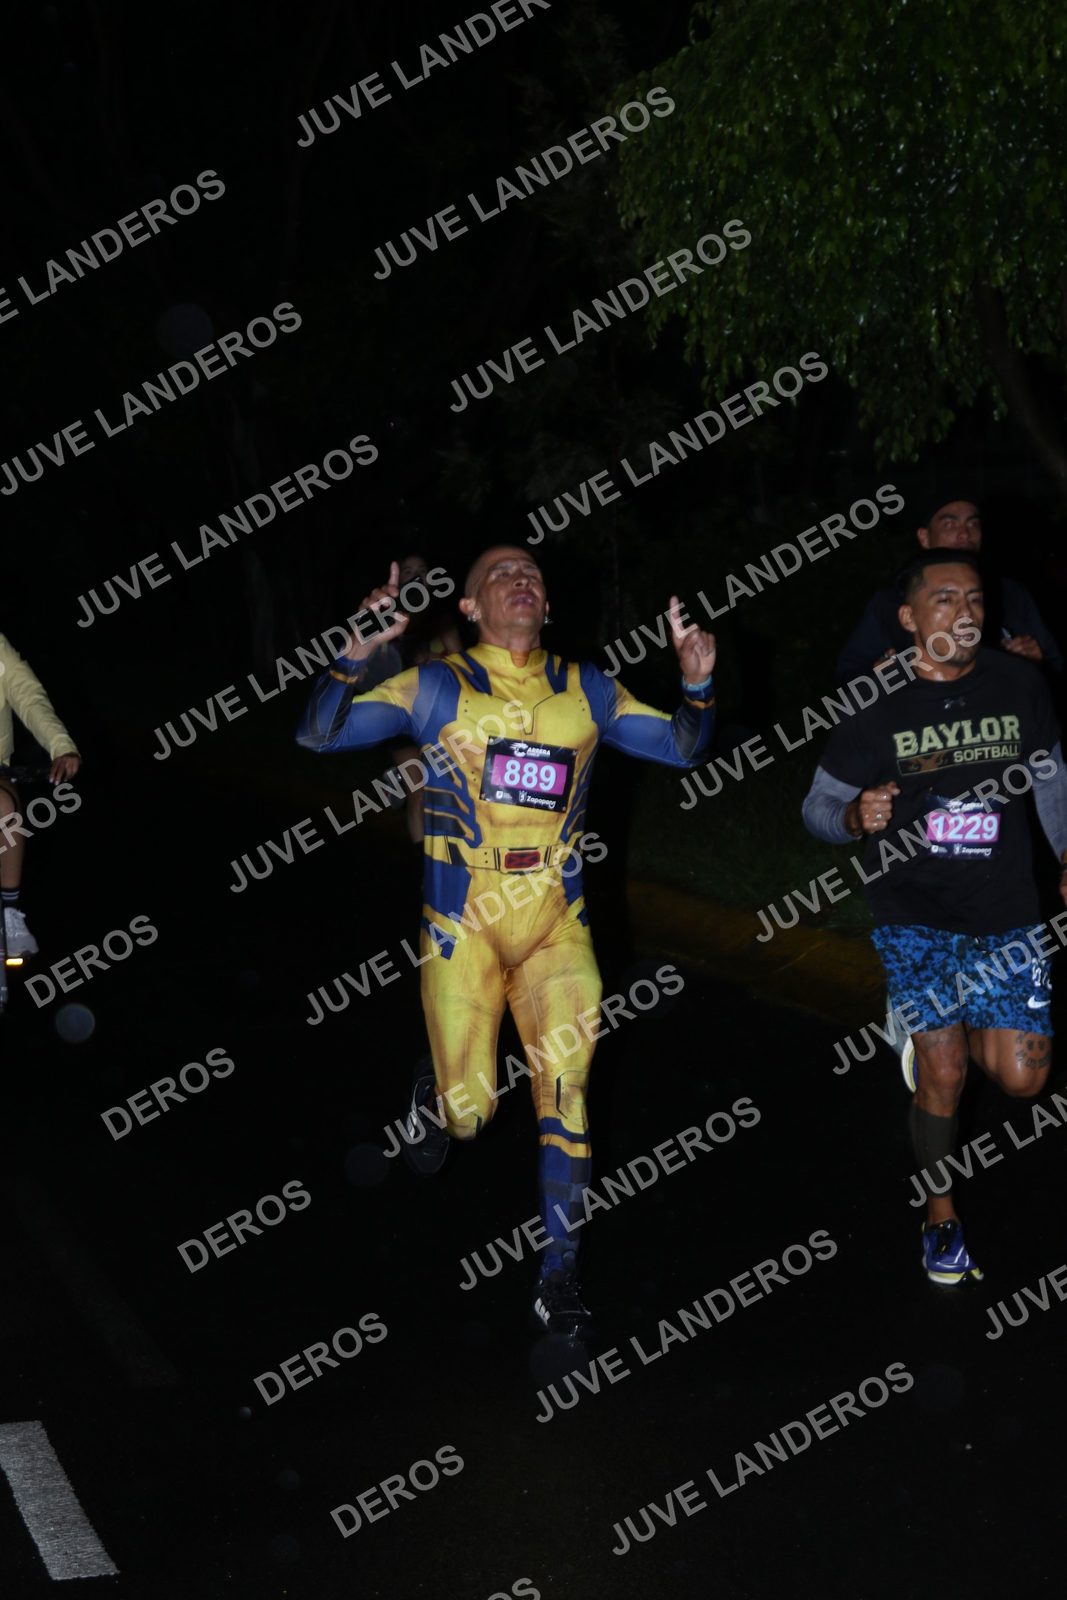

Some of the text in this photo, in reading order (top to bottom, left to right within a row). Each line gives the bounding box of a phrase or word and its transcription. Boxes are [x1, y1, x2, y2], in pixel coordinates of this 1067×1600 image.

[893, 715, 1020, 758] BAYLOR
[953, 744, 1019, 763] SOFTBALL
[504, 759, 556, 791] 889
[932, 815, 999, 841] 1229
